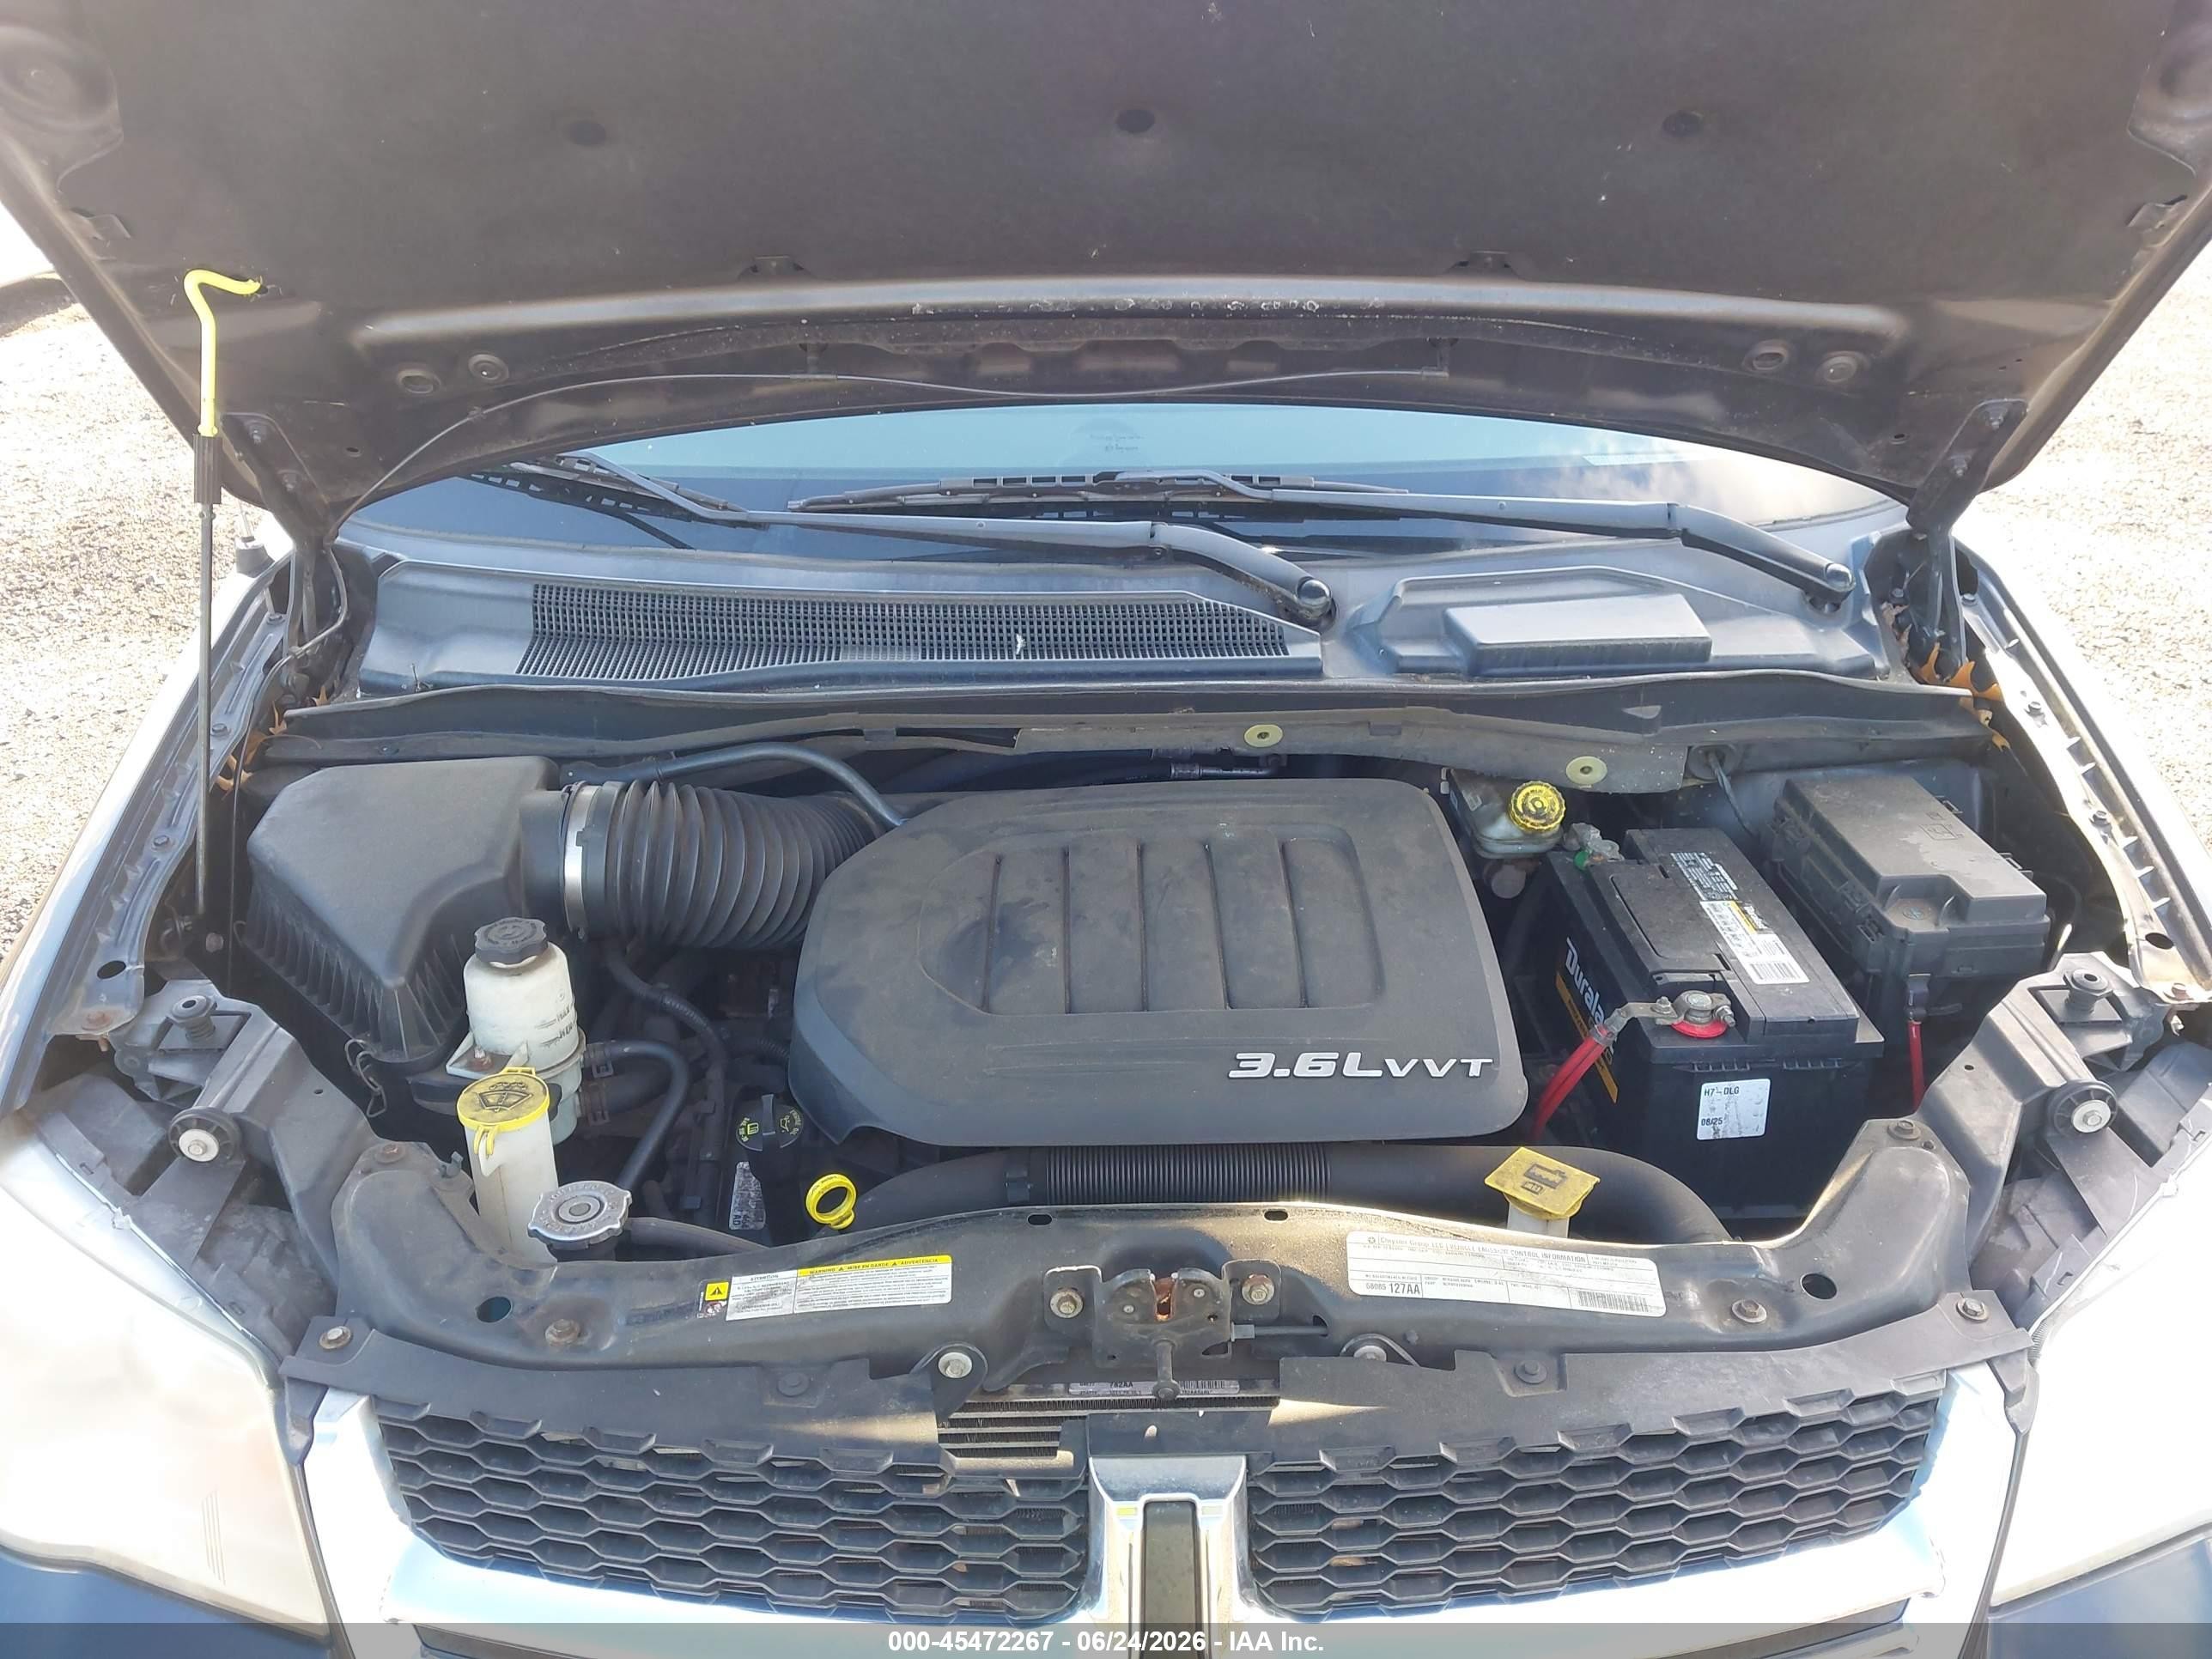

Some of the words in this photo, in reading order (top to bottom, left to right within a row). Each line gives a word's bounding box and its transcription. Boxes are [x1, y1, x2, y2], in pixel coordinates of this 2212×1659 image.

[1229, 1052, 1382, 1078] 3.6L
[1384, 1058, 1493, 1077] VVT
[1701, 1117, 1723, 1127] 08/25
[1510, 1249, 1539, 1258] CONTROL
[1541, 1253, 1587, 1263] INFORMATION
[1389, 1283, 1420, 1294] 127AA
